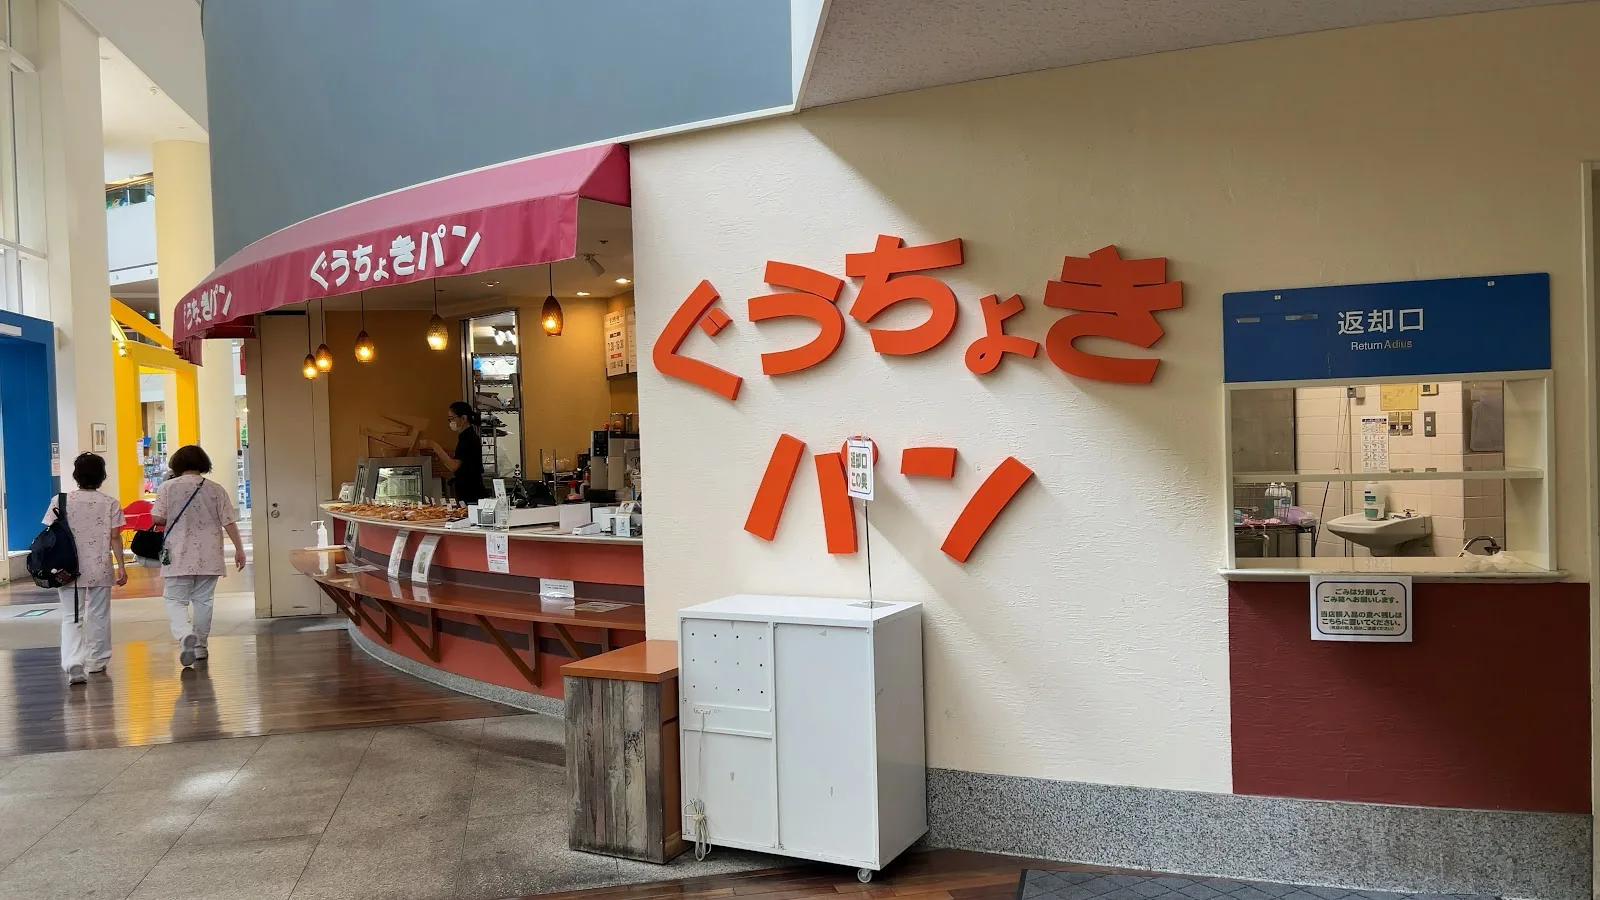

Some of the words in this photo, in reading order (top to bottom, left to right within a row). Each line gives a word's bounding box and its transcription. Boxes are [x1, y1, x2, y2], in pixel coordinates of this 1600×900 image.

[310, 224, 482, 291] ぐうちょきパン
[652, 234, 1183, 401] ぐうちょき
[1337, 308, 1424, 336] 返却口
[743, 433, 1035, 564] パン
[1335, 588, 1387, 596] ごみは分別して
